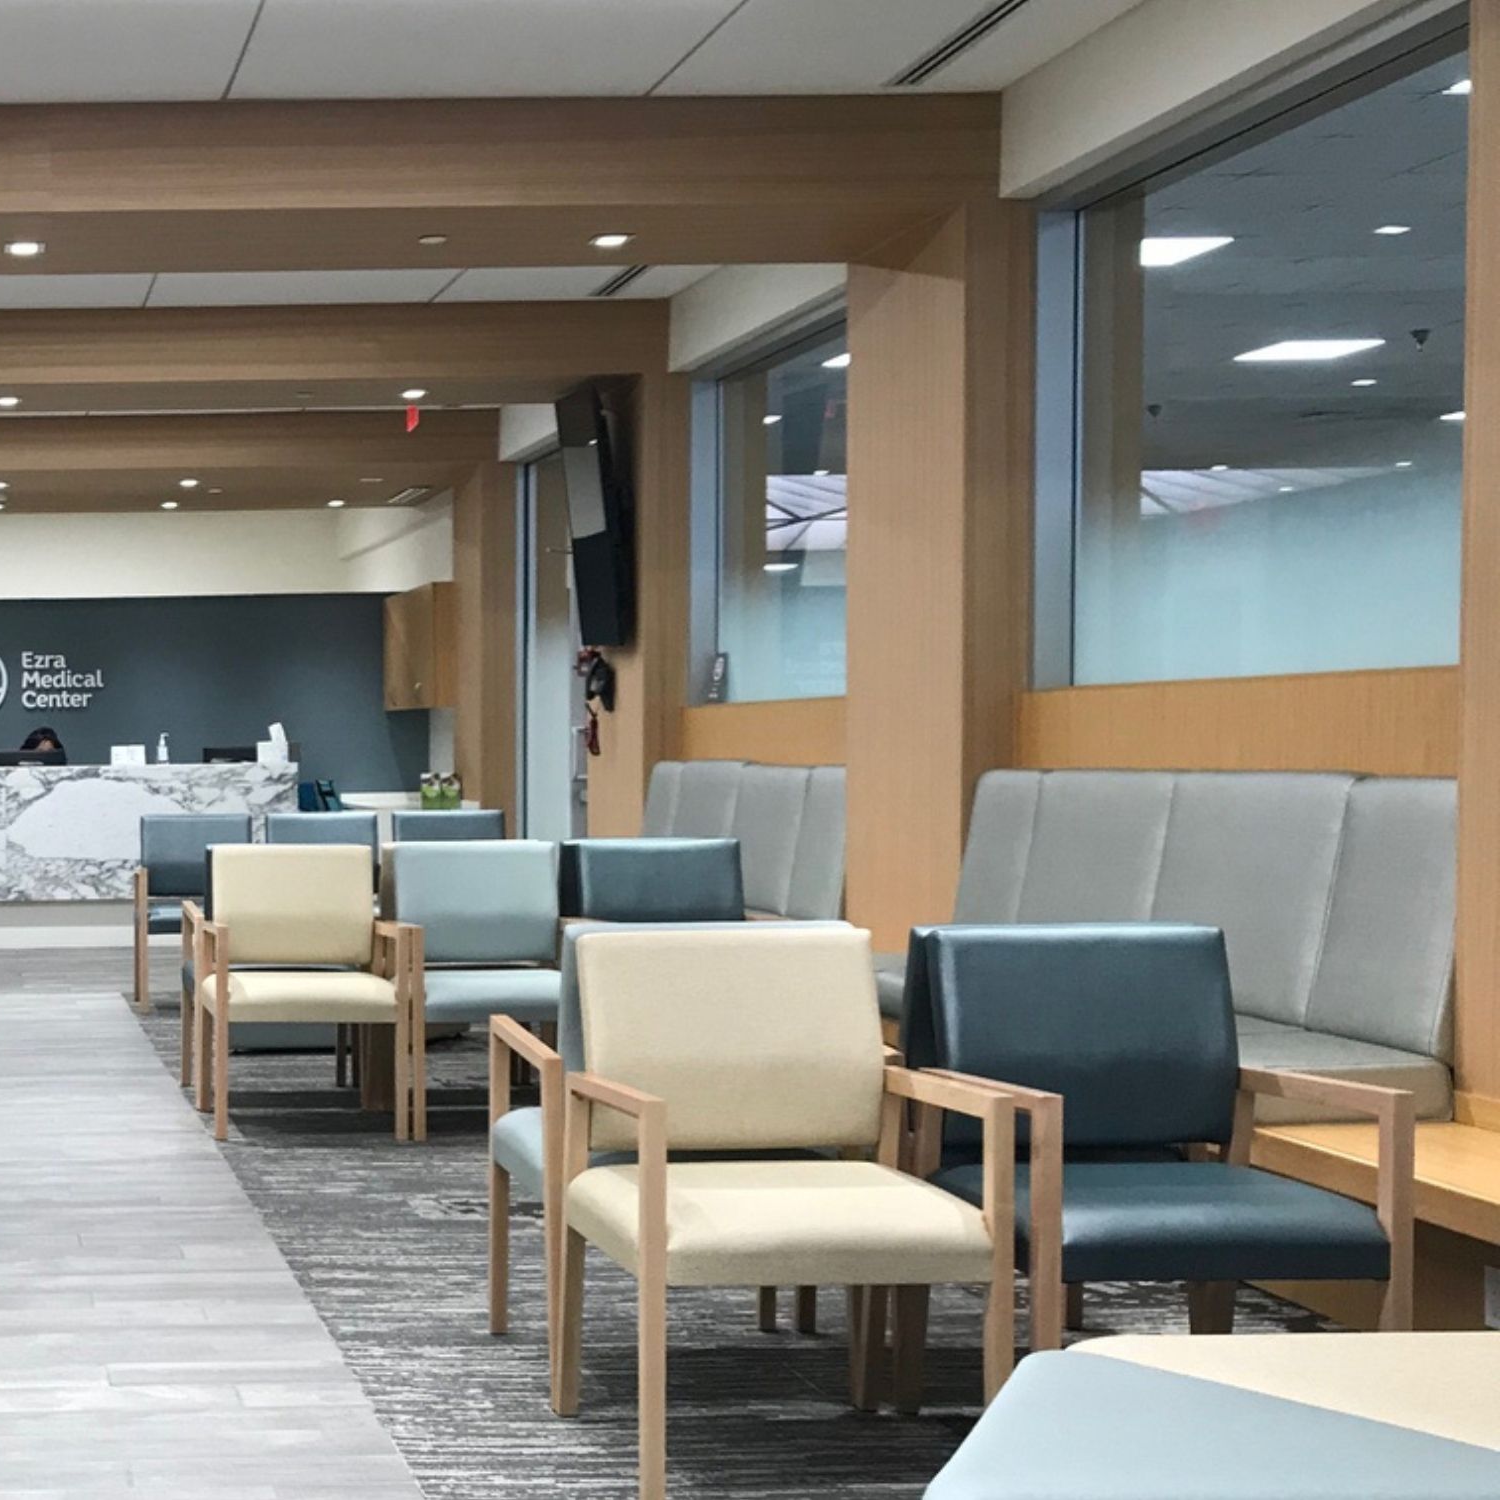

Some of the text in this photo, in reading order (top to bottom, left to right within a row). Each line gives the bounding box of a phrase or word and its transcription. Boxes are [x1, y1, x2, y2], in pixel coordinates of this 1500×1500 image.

[21, 651, 67, 669] Ezra
[21, 669, 104, 689] Medical
[21, 690, 93, 708] Center
